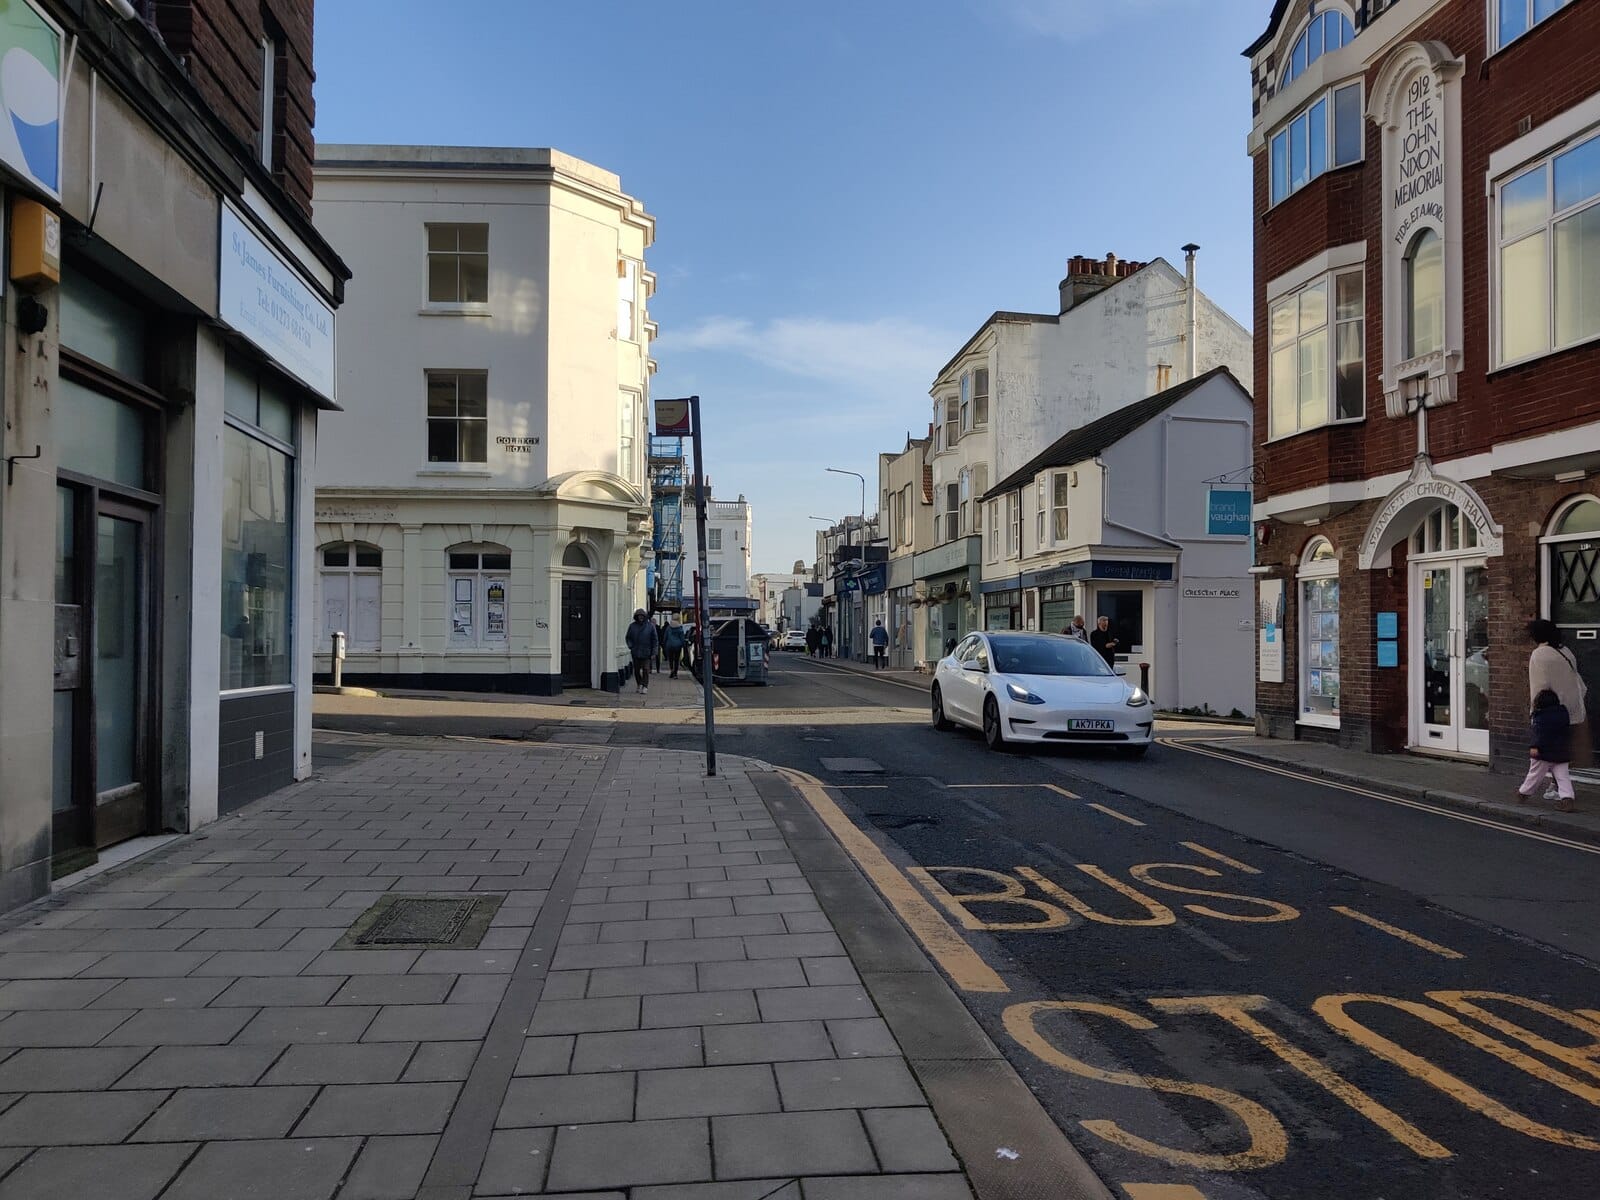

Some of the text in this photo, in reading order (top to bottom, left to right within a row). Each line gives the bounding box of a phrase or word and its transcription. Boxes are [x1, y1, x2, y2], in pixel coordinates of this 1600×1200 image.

[1408, 75, 1430, 106] 1912
[1406, 98, 1434, 130] THE
[1400, 118, 1437, 162] JOHN
[1400, 141, 1440, 183] NIXON
[1410, 206, 1419, 222] ET
[232, 231, 241, 256] St
[241, 240, 266, 281] James
[266, 265, 305, 321] Furnishing
[1210, 511, 1250, 524] vaughan
[1416, 482, 1456, 499] CHVRCH
[1464, 498, 1486, 535] HALL
[1075, 719, 1111, 729] AK71 PKA
[906, 862, 1300, 932] BUS
